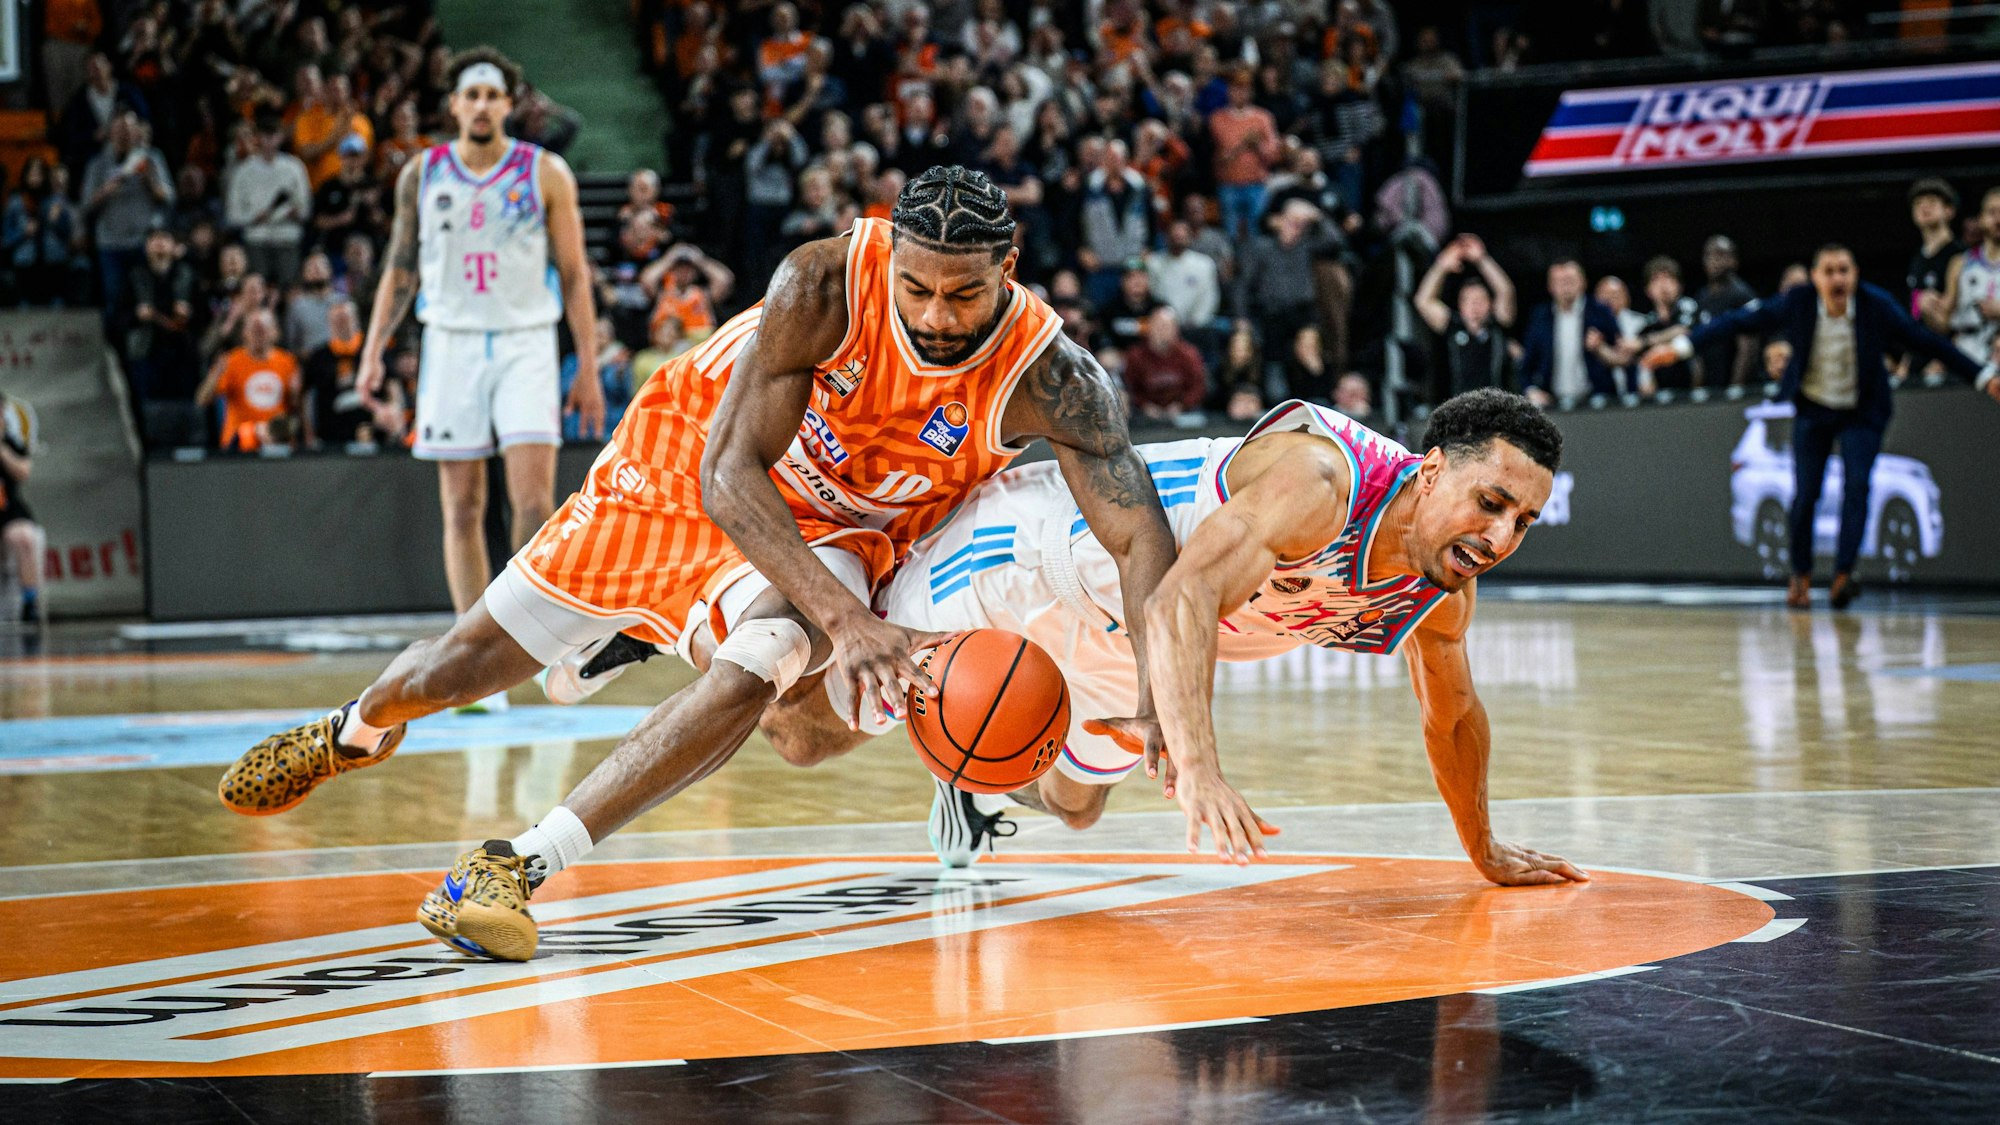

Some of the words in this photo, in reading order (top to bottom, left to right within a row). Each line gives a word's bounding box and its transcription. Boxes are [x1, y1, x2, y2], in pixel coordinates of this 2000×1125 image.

[1650, 80, 1812, 123] LIQUI
[1629, 118, 1799, 160] MOLY
[798, 423, 836, 464] OLY
[803, 410, 846, 463] QUI
[923, 428, 950, 453] BBL
[862, 469, 932, 503] 10
